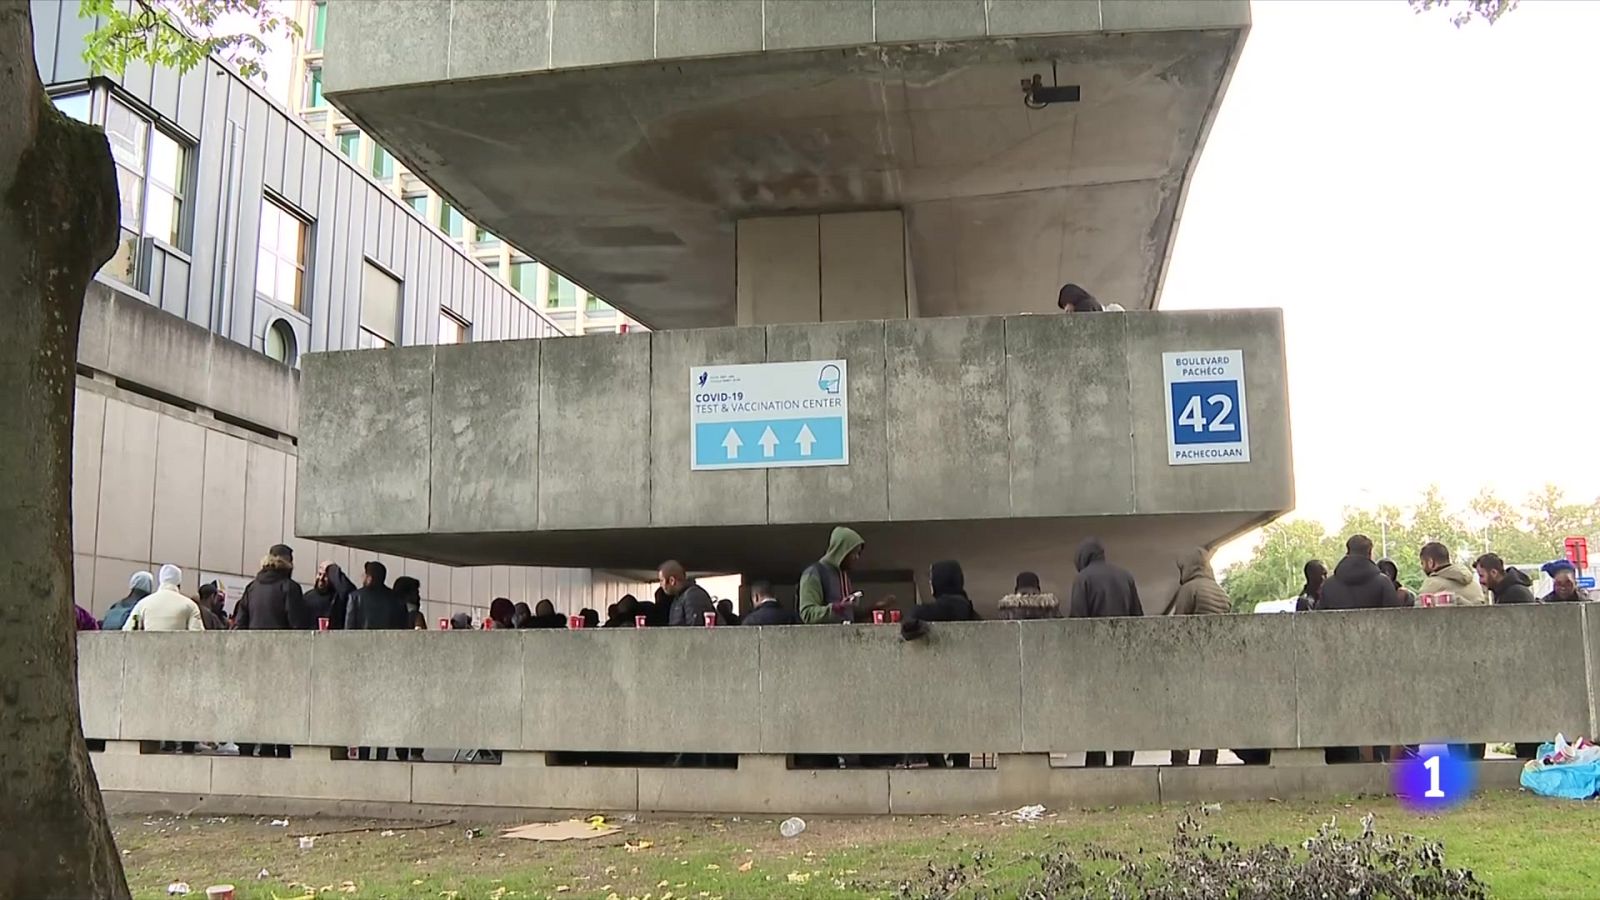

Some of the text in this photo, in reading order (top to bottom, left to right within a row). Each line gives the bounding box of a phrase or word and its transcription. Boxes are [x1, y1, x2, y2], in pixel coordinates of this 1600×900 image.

[1175, 357, 1230, 366] BOULEVARD
[1182, 367, 1225, 376] PACHÉCO
[695, 391, 744, 403] COVID-19
[695, 398, 841, 414] TEST & VACCINATION CENTER
[1178, 394, 1235, 432] 42
[1175, 448, 1243, 458] PACHECOLAAN
